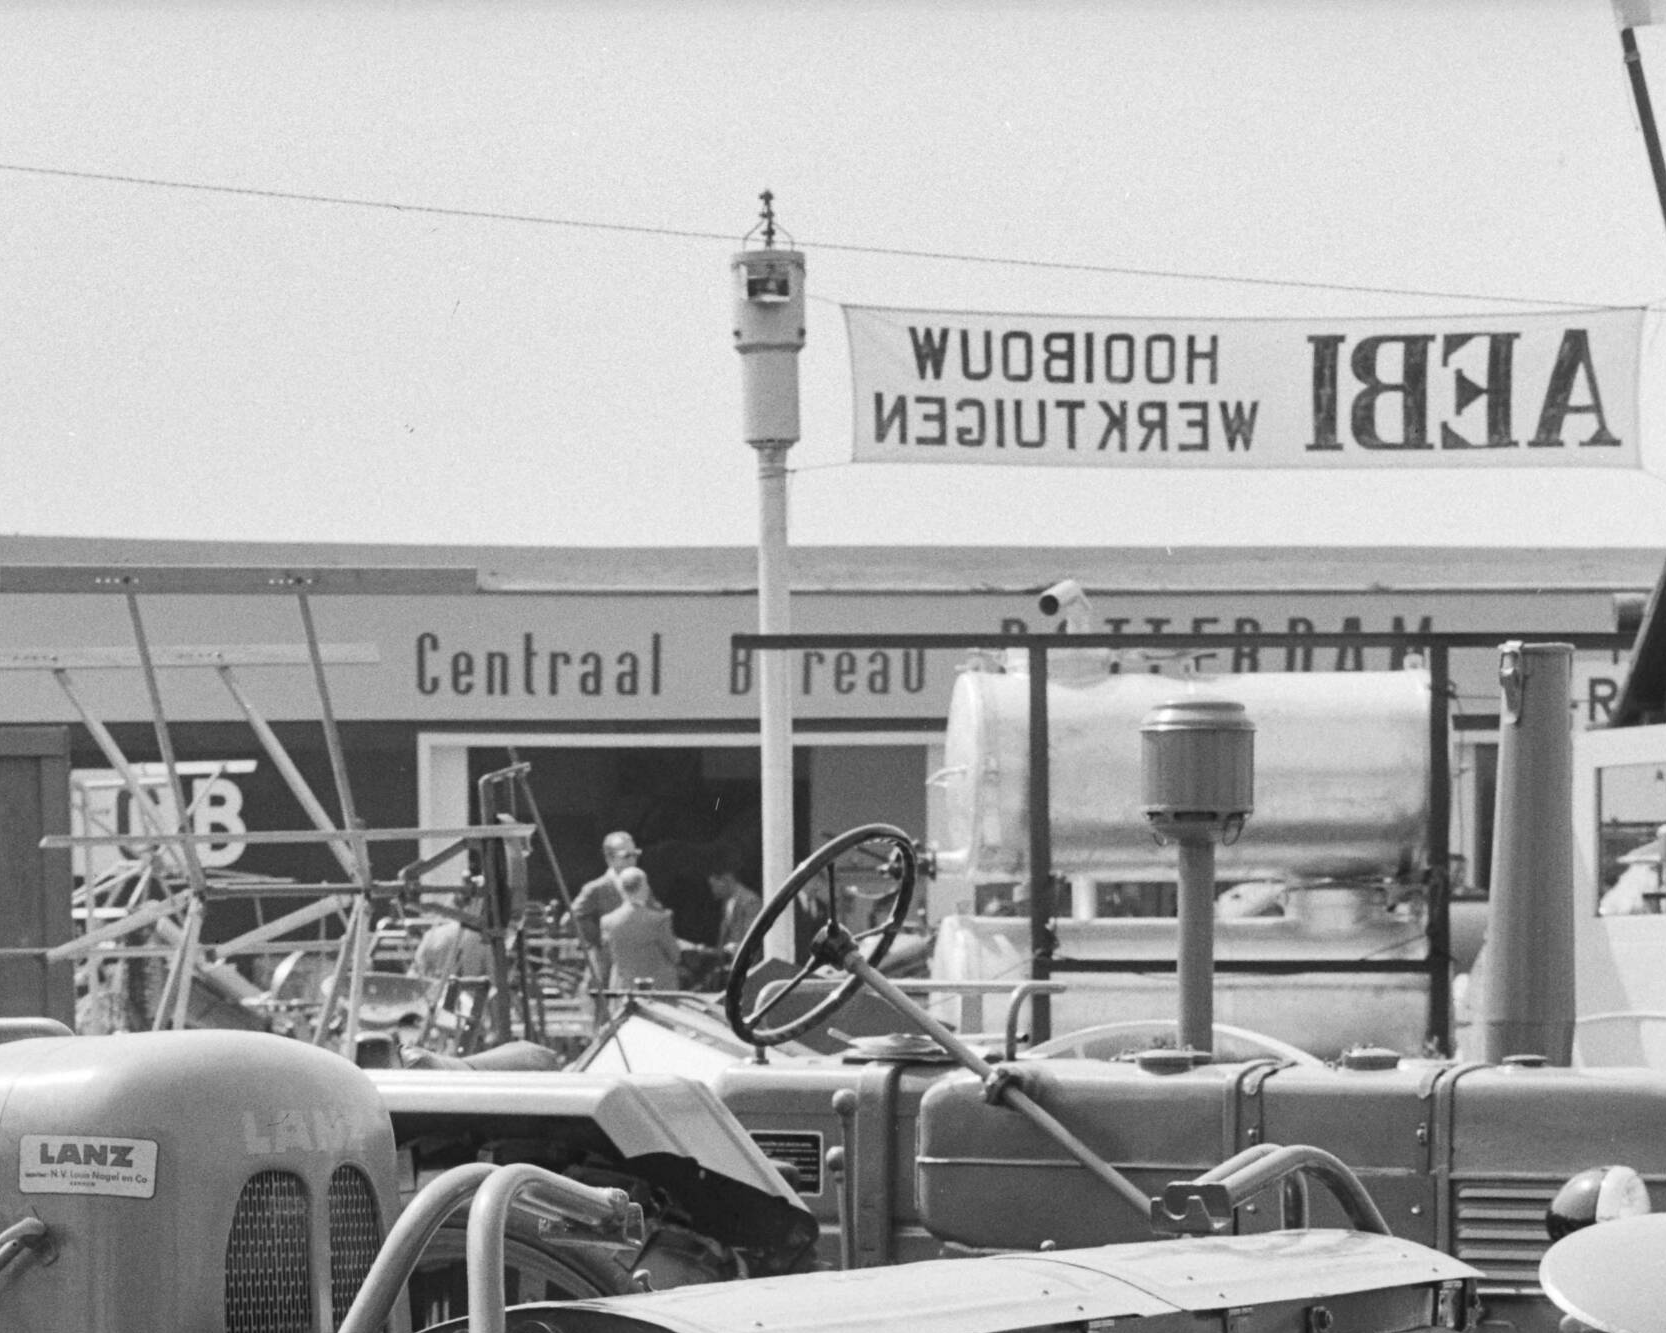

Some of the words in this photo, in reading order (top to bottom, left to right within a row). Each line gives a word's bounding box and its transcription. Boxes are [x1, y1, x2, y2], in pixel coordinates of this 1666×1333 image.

[415, 631, 663, 697] Centraal
[729, 636, 926, 695] Breau
[39, 1142, 135, 1168] LANZ
